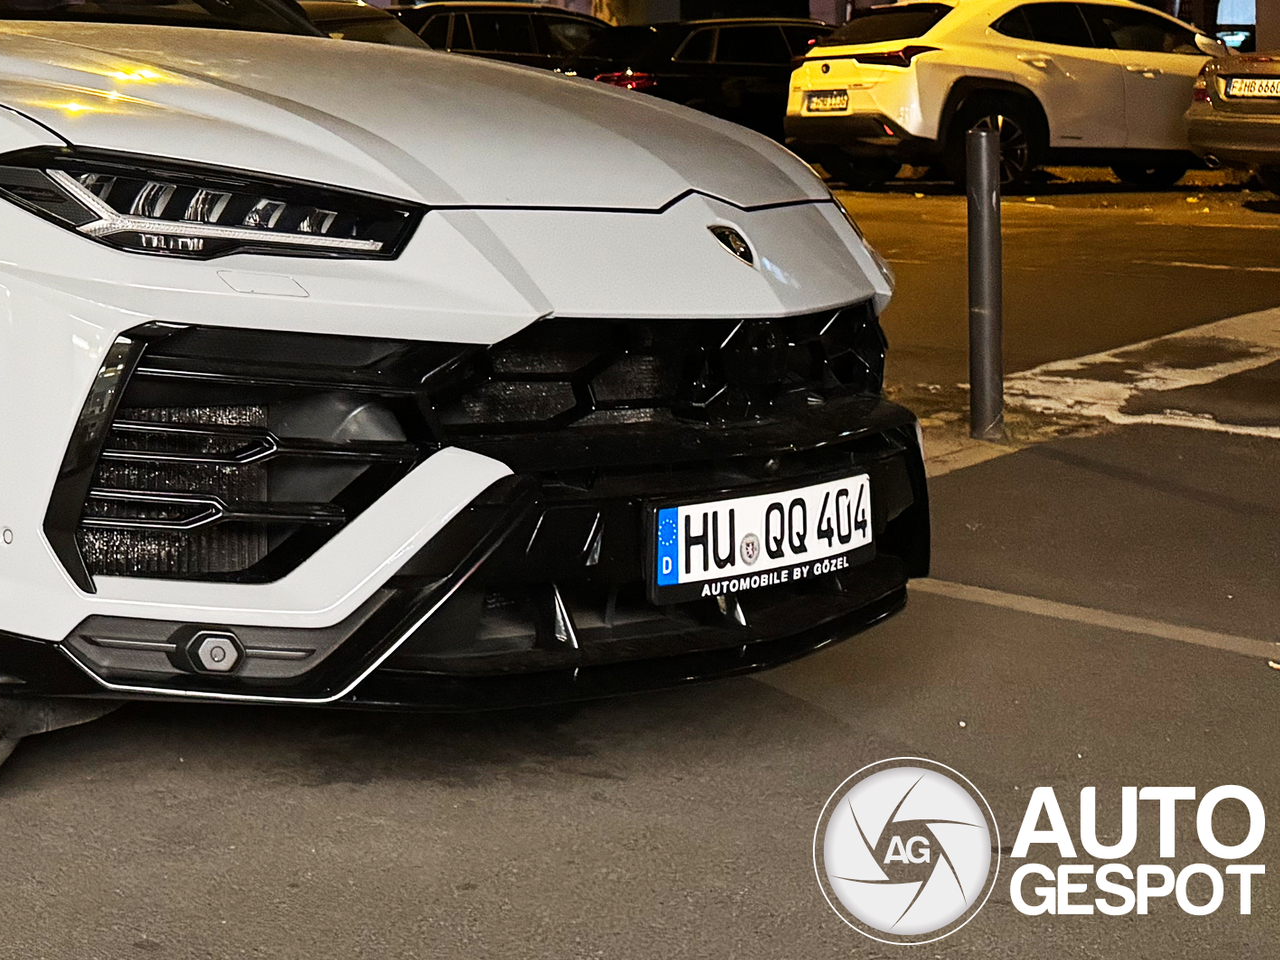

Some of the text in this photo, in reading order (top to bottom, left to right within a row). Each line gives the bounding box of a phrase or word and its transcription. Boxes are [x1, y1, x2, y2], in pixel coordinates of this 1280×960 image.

[684, 483, 868, 574] HU QQ 404
[662, 556, 672, 575] D
[701, 556, 850, 597] AUTOMOBILE BY GÖZEL
